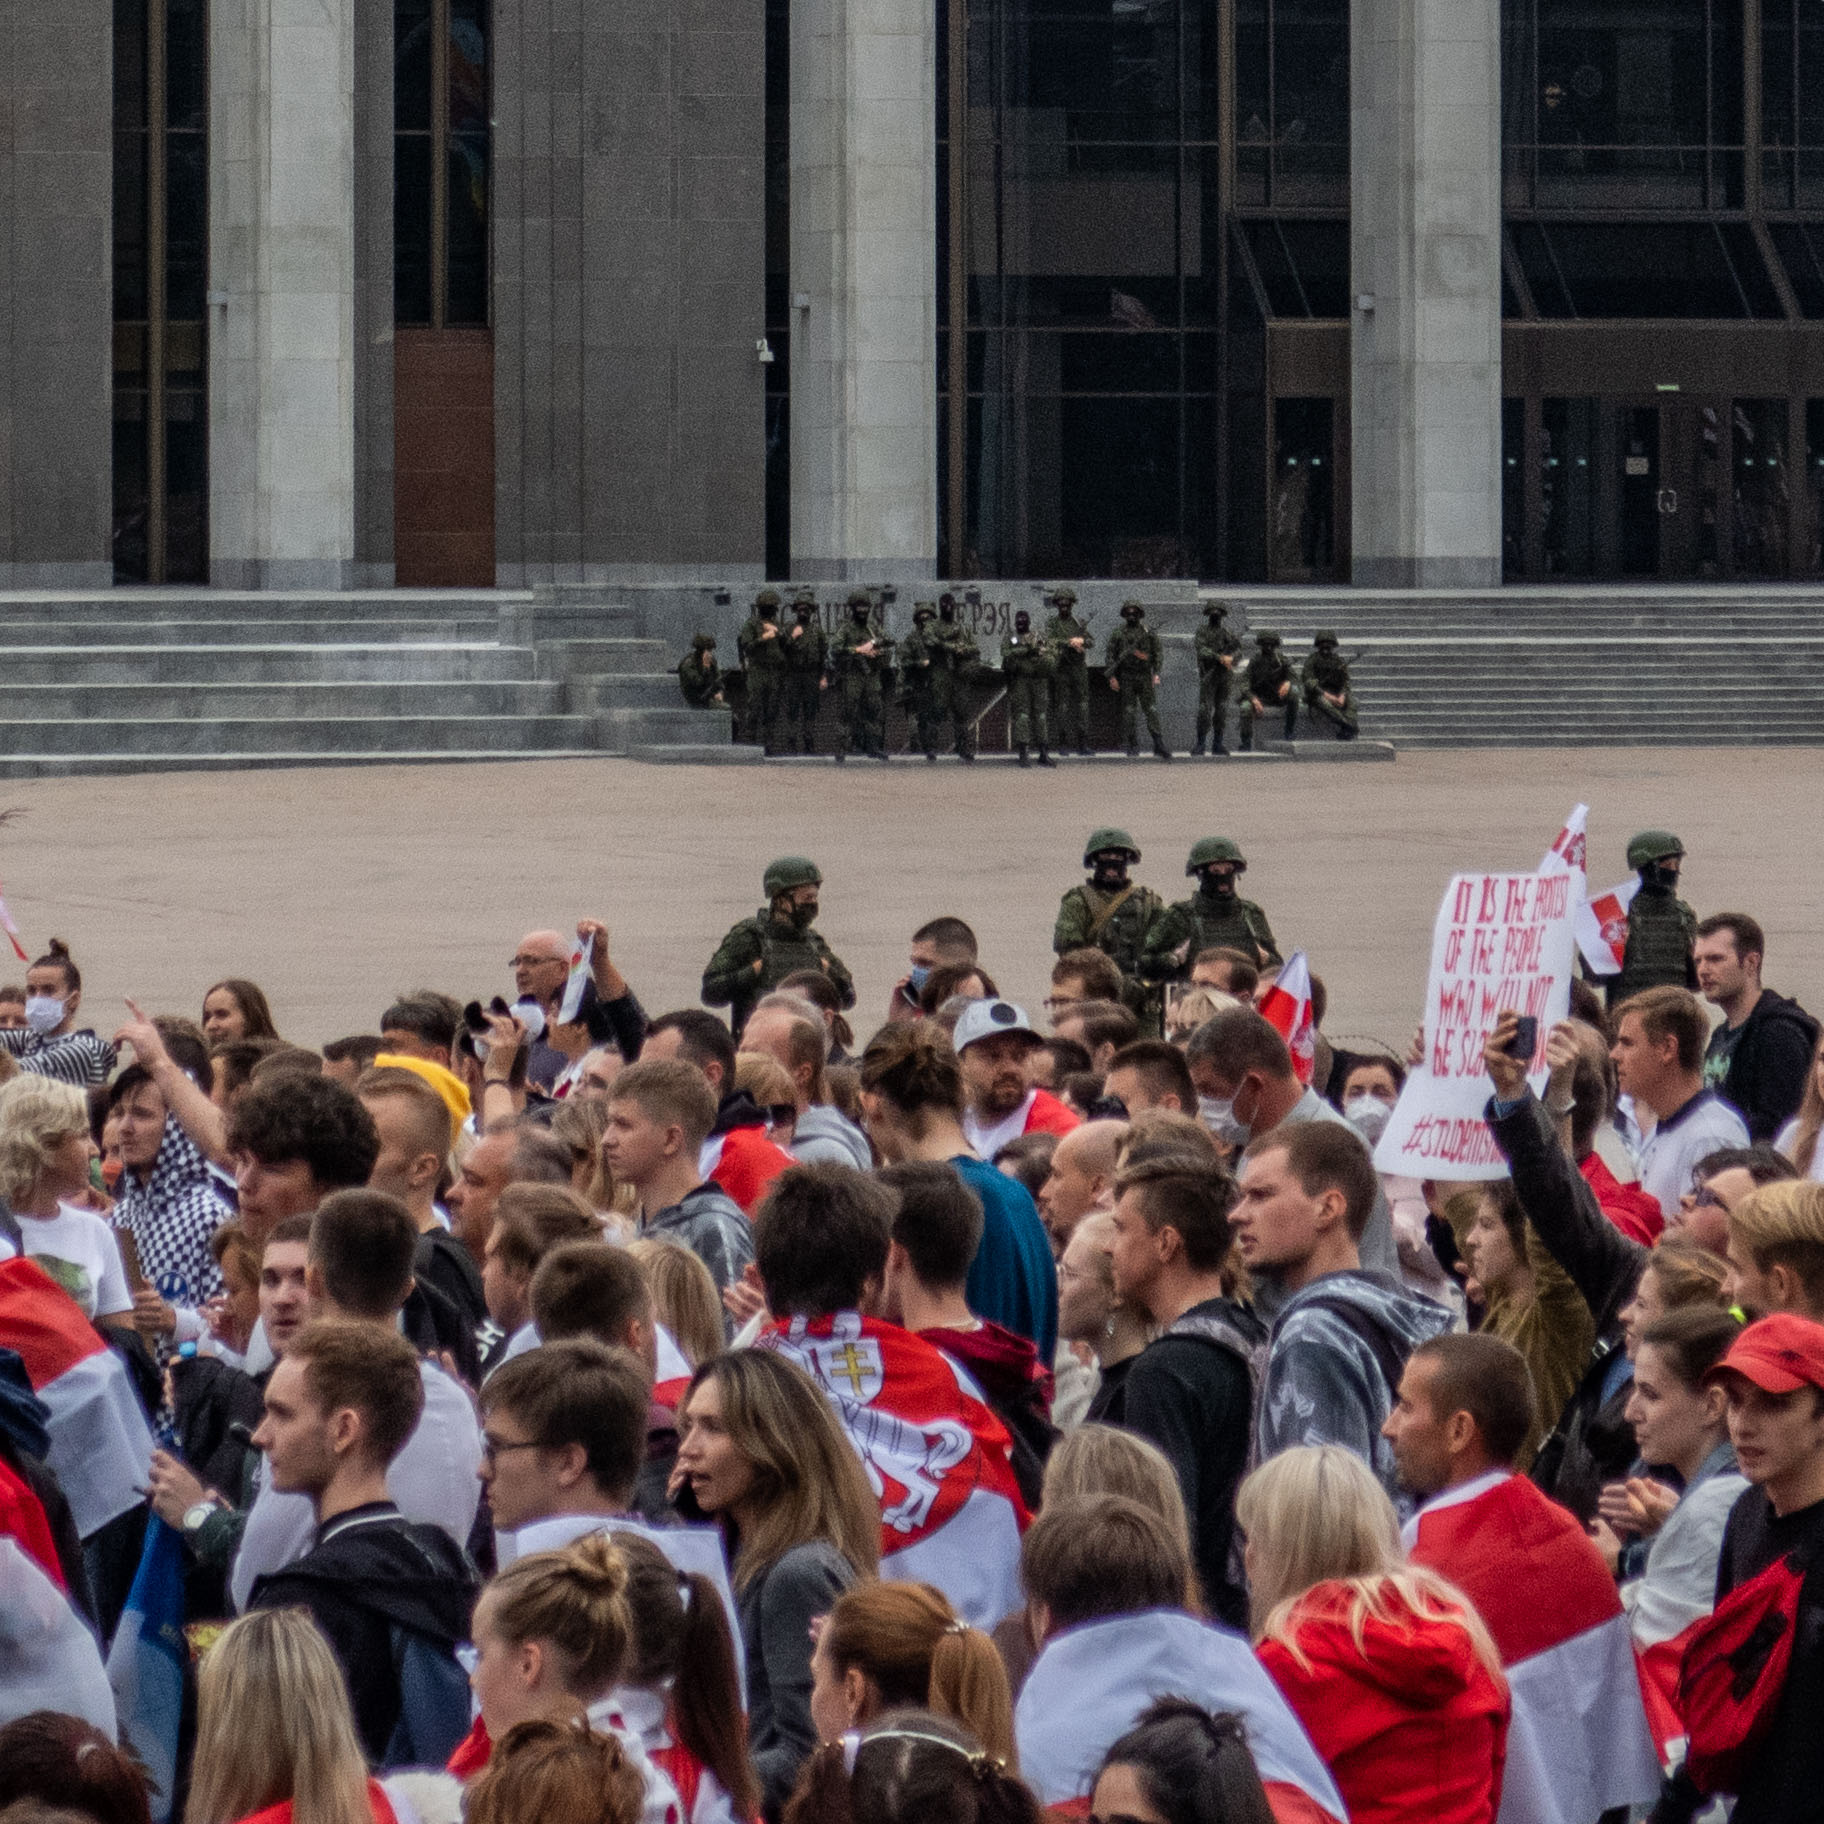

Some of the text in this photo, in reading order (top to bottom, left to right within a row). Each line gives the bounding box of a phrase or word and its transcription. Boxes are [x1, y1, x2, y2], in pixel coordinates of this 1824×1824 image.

[1452, 879, 1474, 924] IT
[1477, 875, 1500, 924] IS
[1531, 874, 1571, 923] PROTEST
[1444, 928, 1466, 974] OF
[1500, 925, 1547, 975] PEOPLE
